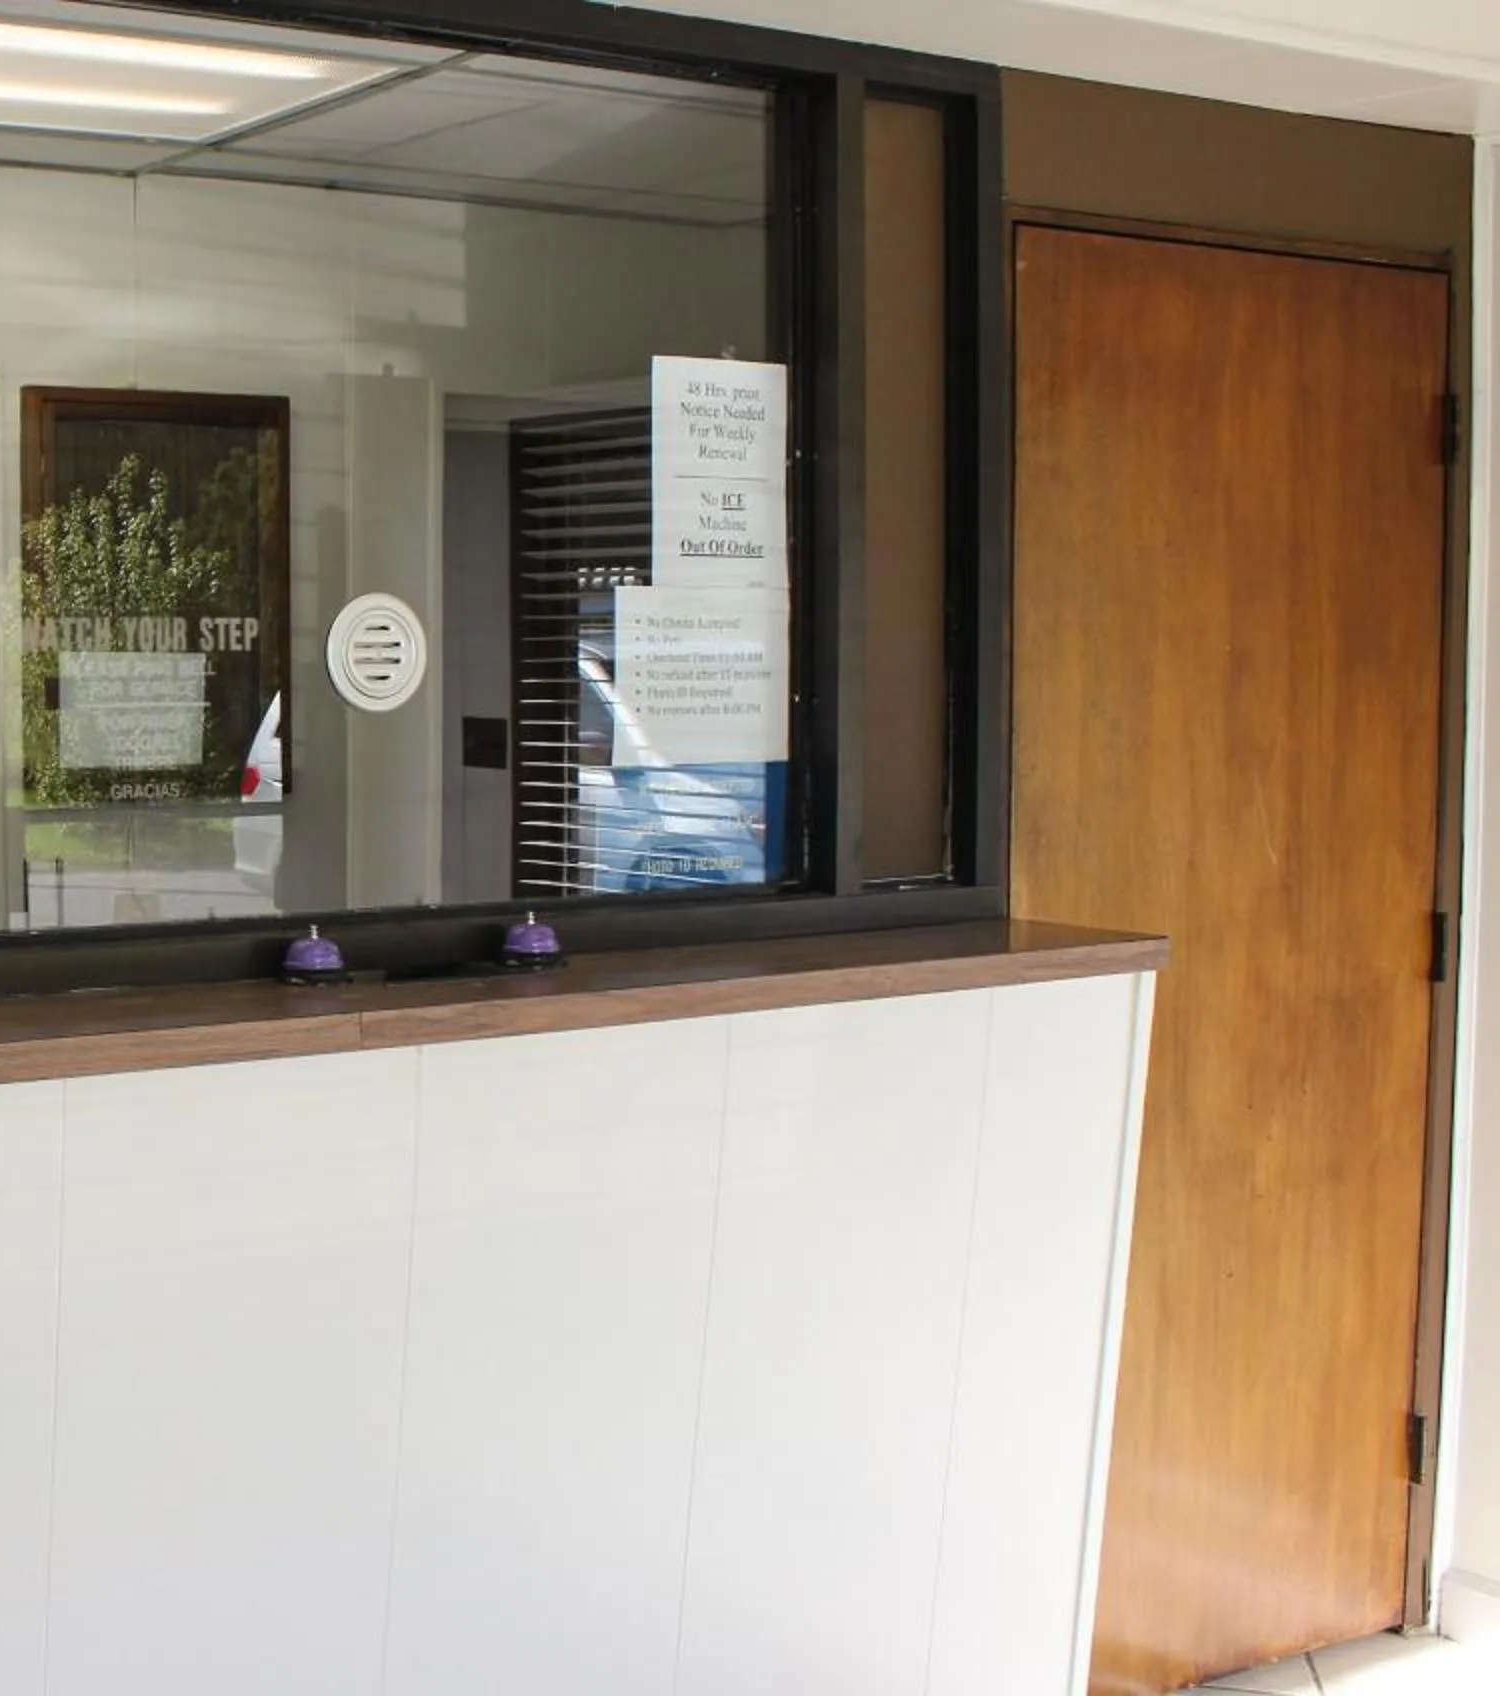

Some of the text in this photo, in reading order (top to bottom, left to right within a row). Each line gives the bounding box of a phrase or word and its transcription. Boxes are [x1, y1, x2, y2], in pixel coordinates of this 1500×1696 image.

[685, 381, 701, 397] 48
[680, 401, 765, 421] Notice Needed
[689, 424, 757, 445] For Weekly
[699, 445, 747, 461] Renewal
[701, 493, 747, 510] No ICE
[699, 515, 748, 531] Machine
[680, 538, 764, 558] Out Of Order
[124, 616, 188, 651] YOUR
[200, 616, 260, 652] STEP
[110, 783, 181, 799] GRACIAS
